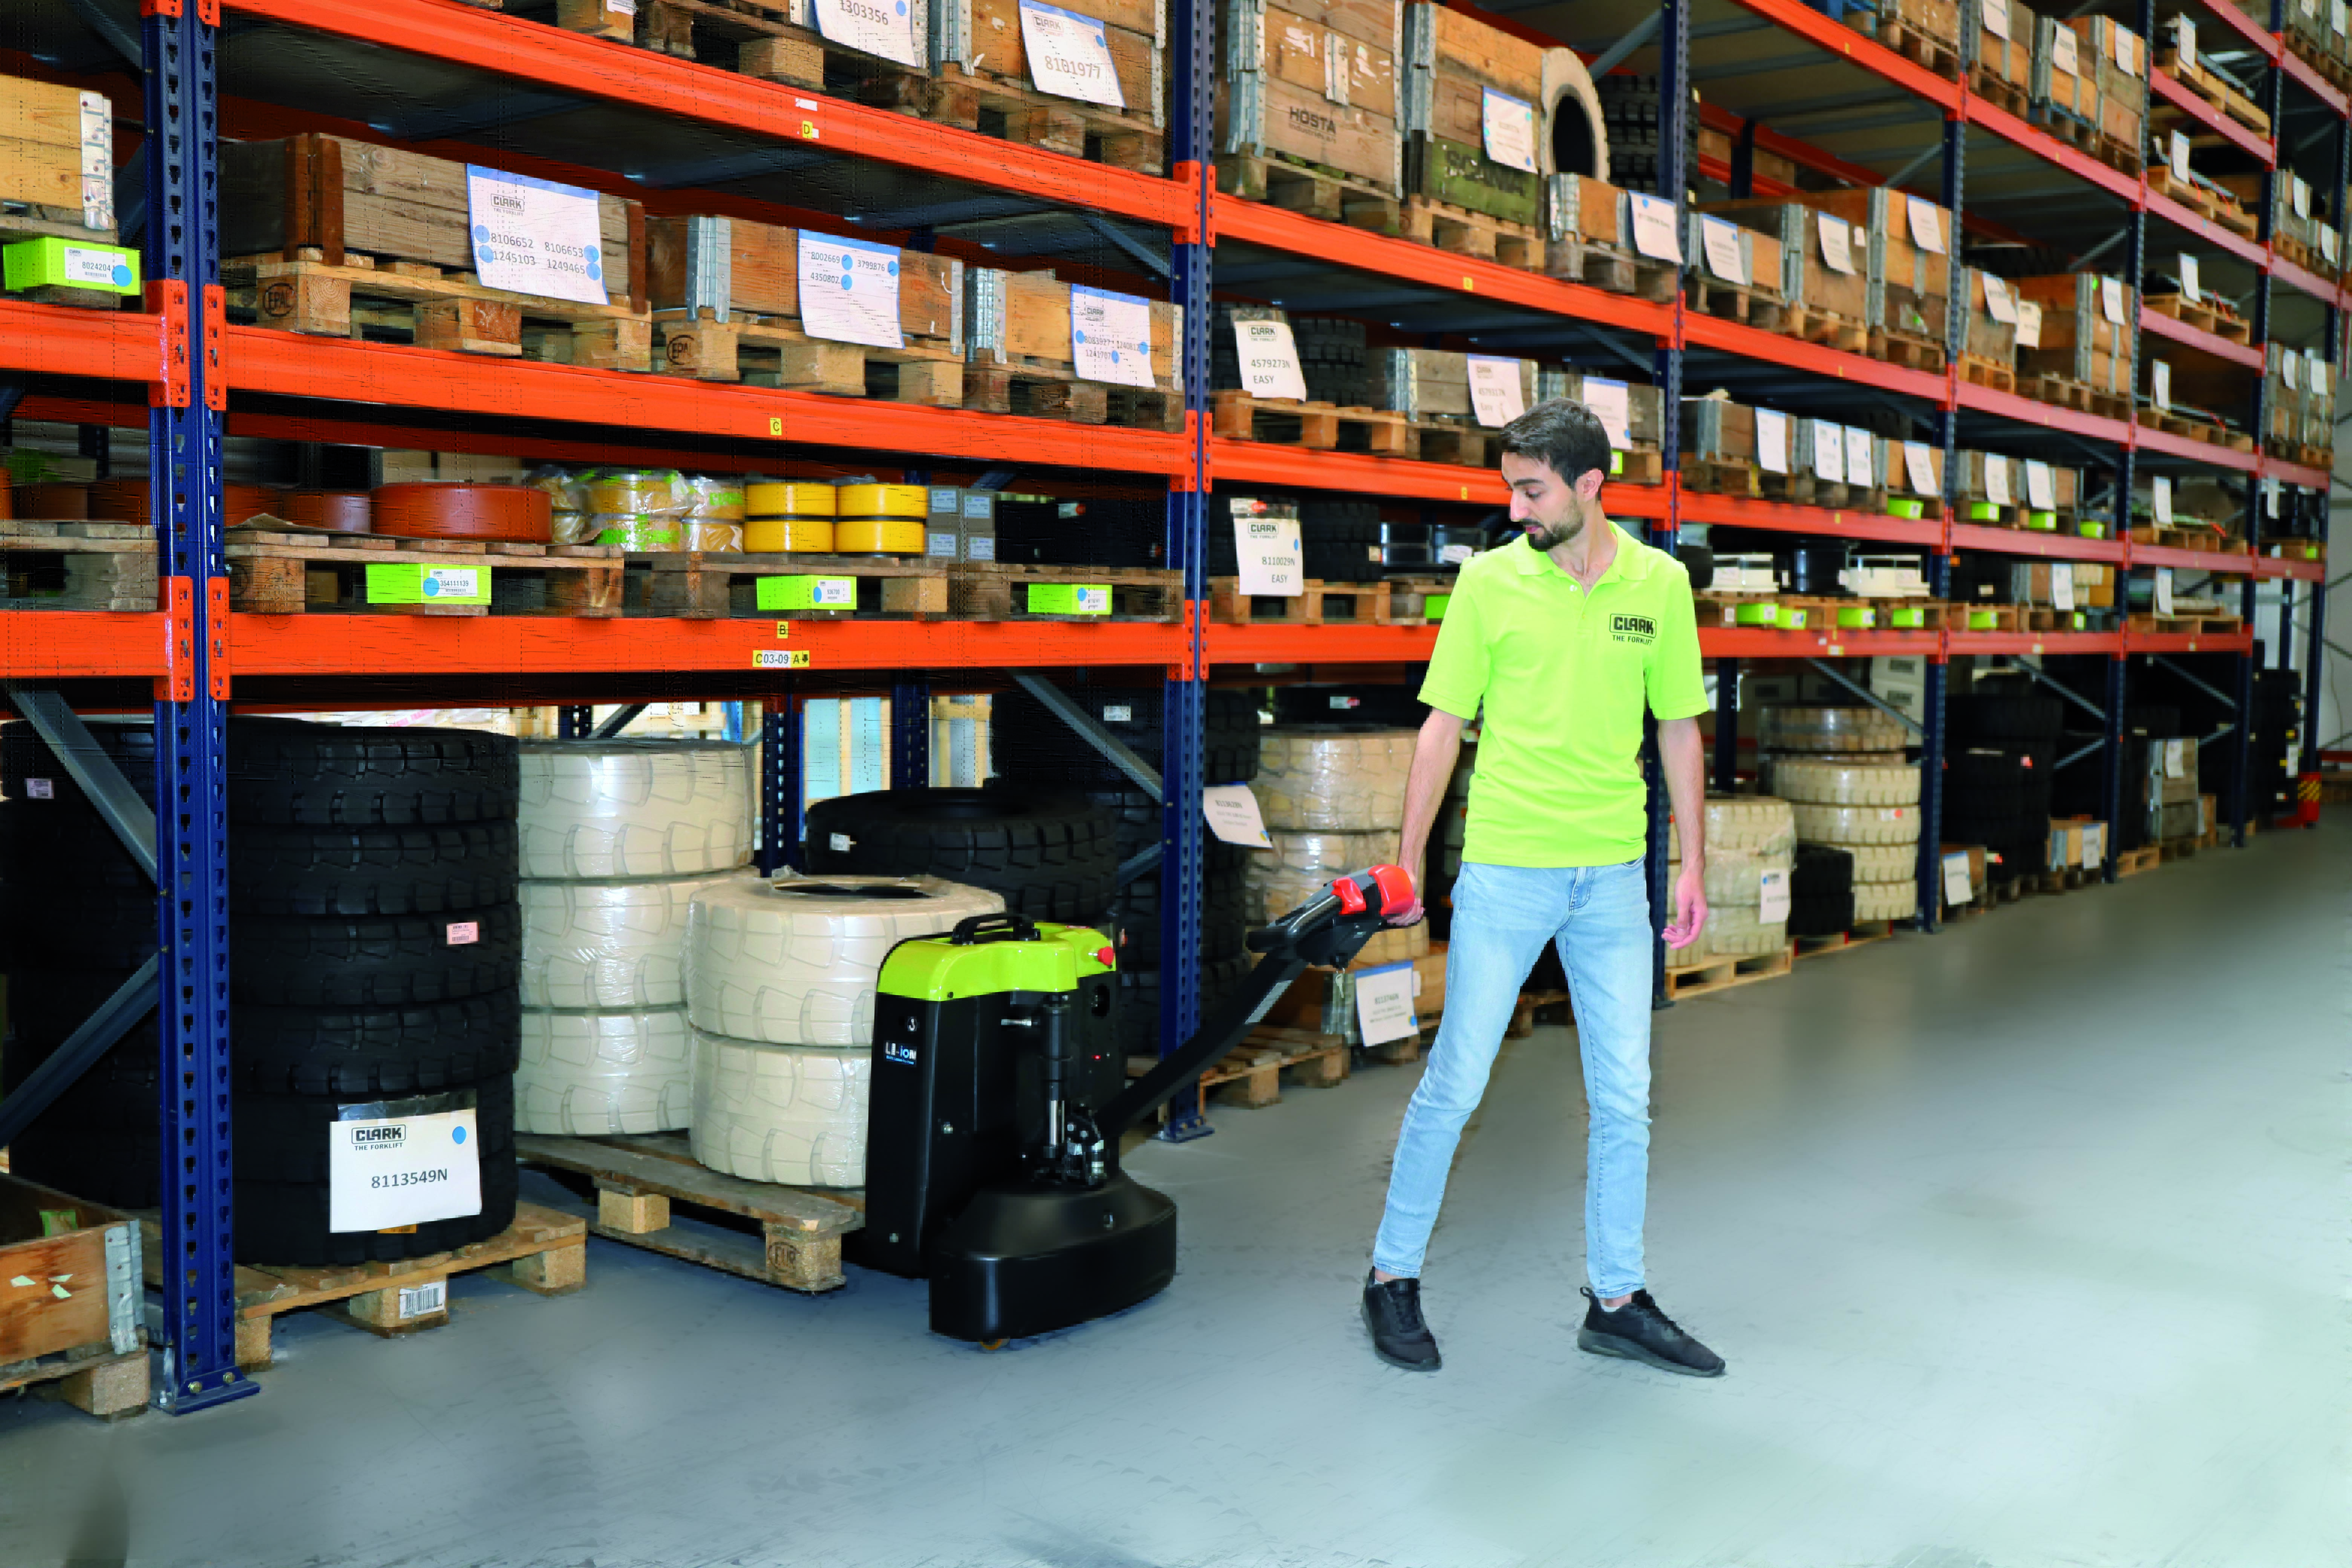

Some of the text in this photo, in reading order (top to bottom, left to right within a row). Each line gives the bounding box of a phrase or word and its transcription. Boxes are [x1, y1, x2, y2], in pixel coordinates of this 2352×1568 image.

[839, 0, 888, 25] 1303356
[1035, 17, 1061, 30] CLARK
[1044, 55, 1100, 79] 8101977
[1290, 106, 1336, 134] HOSTA
[804, 124, 810, 134] D
[493, 196, 522, 209] CLARK
[491, 233, 583, 257] 8106652 8106653
[82, 262, 111, 271] 8024204
[493, 251, 585, 274] 1245103 1249465
[811, 252, 885, 271] 8002669 3799876
[810, 272, 839, 283] 4350807
[1251, 327, 1276, 335] CLARK
[1251, 359, 1290, 368] 4579273N
[1253, 375, 1274, 384] EASY
[773, 421, 779, 431] C
[1262, 557, 1295, 566] 8110029N
[1272, 574, 1288, 583] EASY
[779, 625, 786, 635] B
[1614, 617, 1654, 635] CLARK
[1628, 636, 1652, 646] FORKLIFT
[793, 654, 799, 664] A
[356, 1127, 401, 1141] CLARK
[371, 1168, 447, 1188] 8113549N
